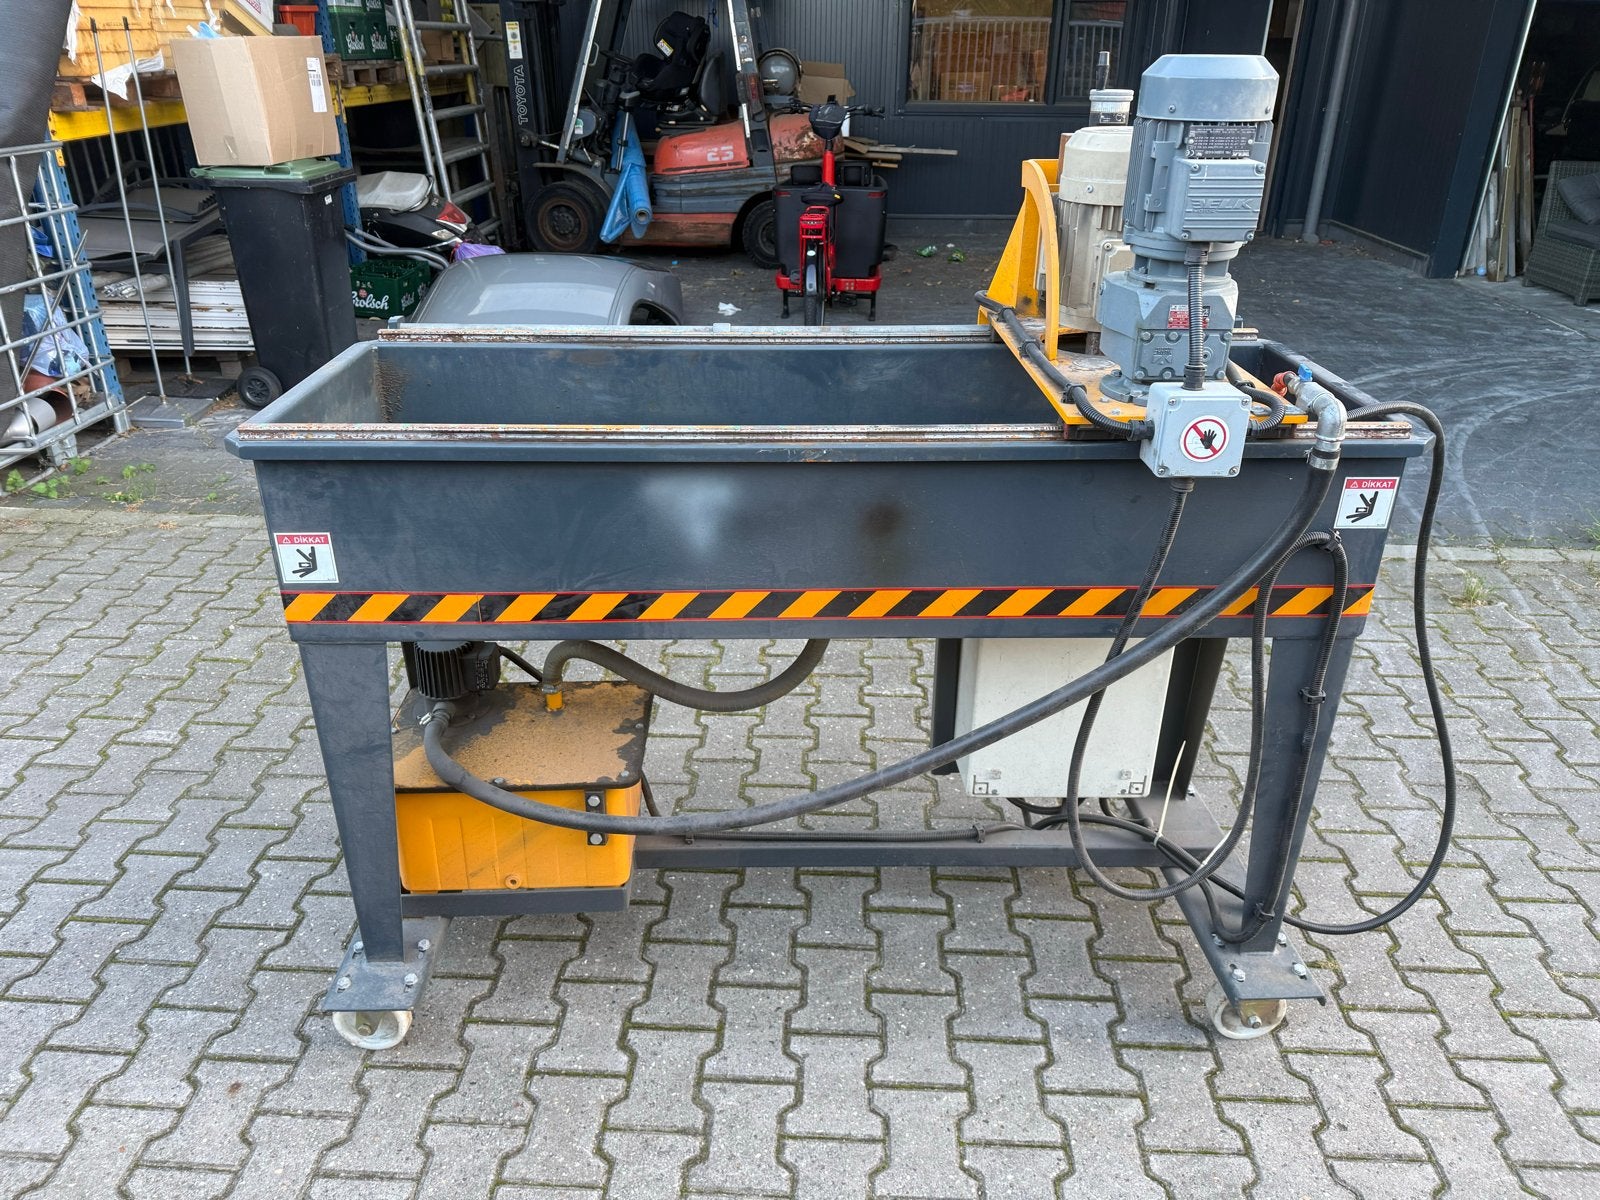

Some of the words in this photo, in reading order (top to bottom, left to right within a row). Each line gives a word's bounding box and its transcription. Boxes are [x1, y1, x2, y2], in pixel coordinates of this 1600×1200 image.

[513, 64, 529, 125] TOYOTA
[1362, 480, 1392, 488] DİKKAT
[293, 536, 325, 544] DİKKAT
